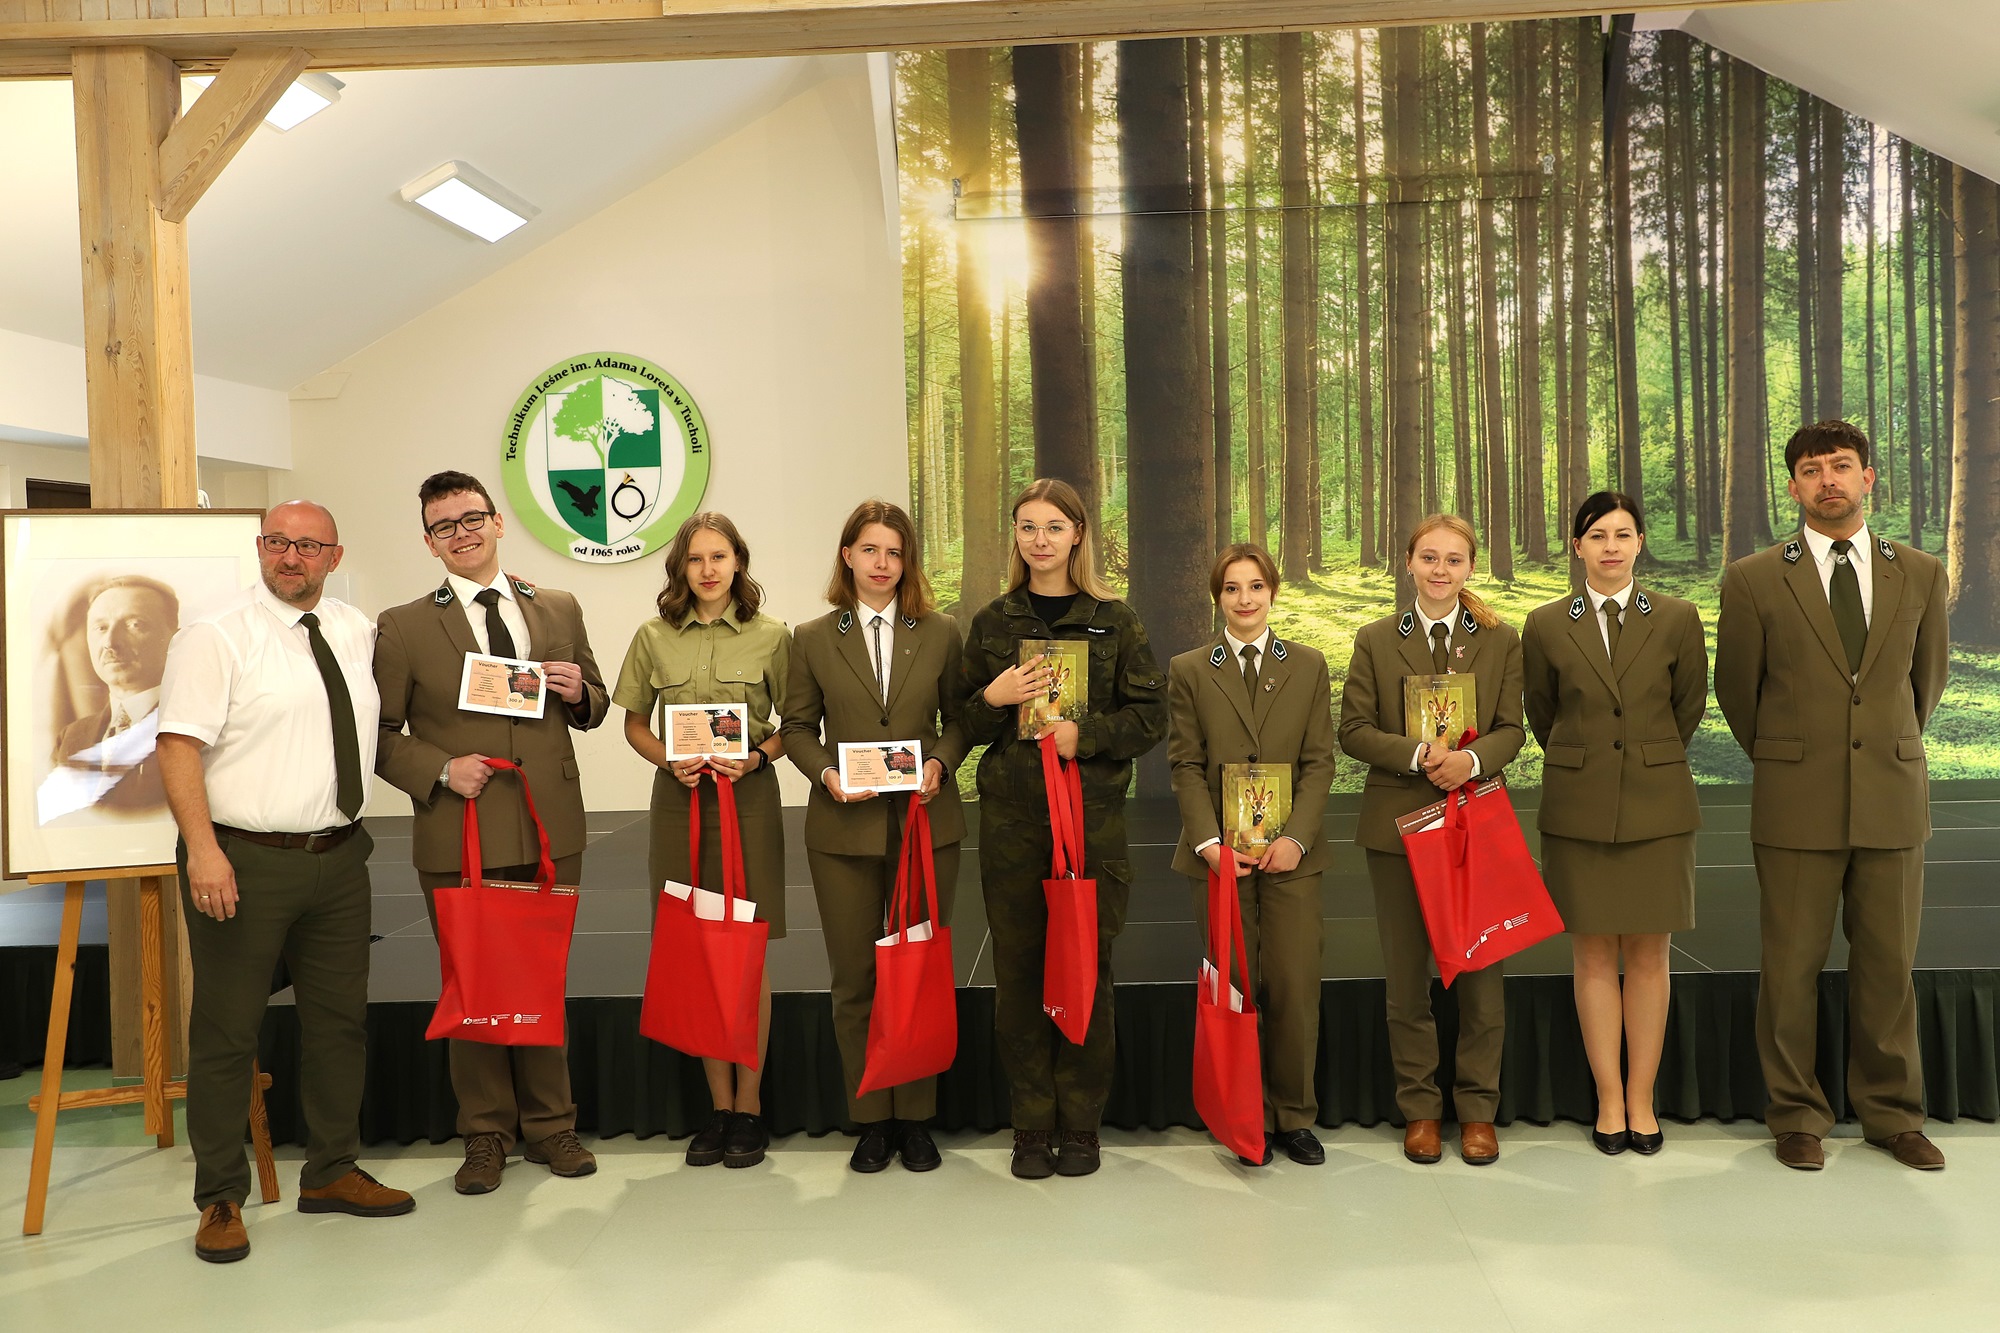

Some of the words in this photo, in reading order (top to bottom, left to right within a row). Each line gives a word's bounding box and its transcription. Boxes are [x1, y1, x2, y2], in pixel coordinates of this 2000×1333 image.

[506, 394, 539, 461] Technikum
[535, 368, 569, 395] Leśne
[570, 360, 591, 374] im.
[594, 357, 637, 373] Adama
[639, 366, 674, 398] Loreta
[673, 396, 684, 407] w
[680, 405, 703, 454] Tucholi
[574, 545, 587, 556] od
[590, 548, 613, 557] 1965
[616, 543, 641, 556] roku
[478, 661, 498, 669] Voucher
